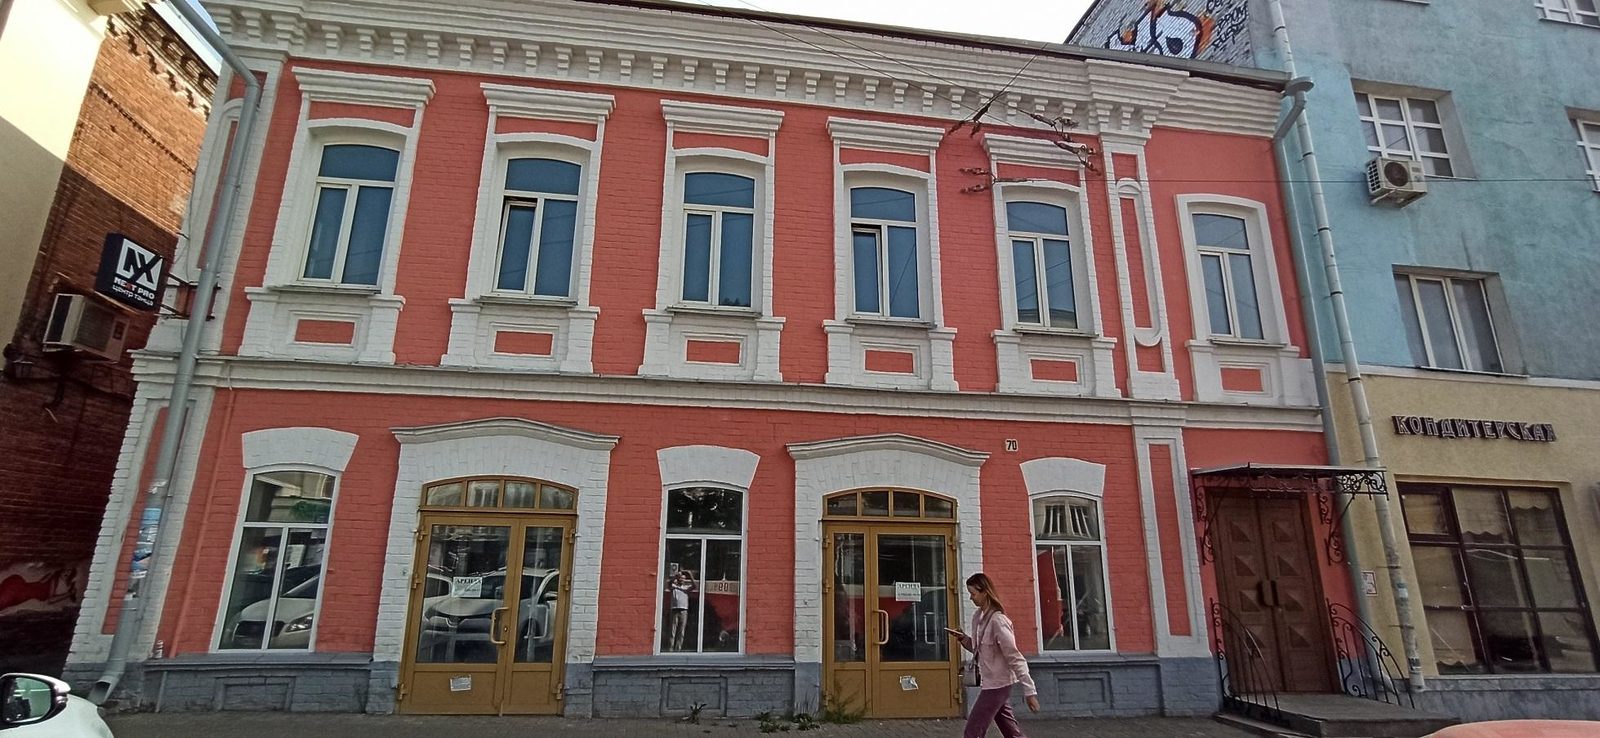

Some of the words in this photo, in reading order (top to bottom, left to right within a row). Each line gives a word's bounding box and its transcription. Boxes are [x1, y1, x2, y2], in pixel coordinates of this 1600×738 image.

[137, 287, 155, 300] PRO
[1391, 415, 1557, 442] КОНДИТЕРСКАЯ
[1006, 440, 1017, 450] 70
